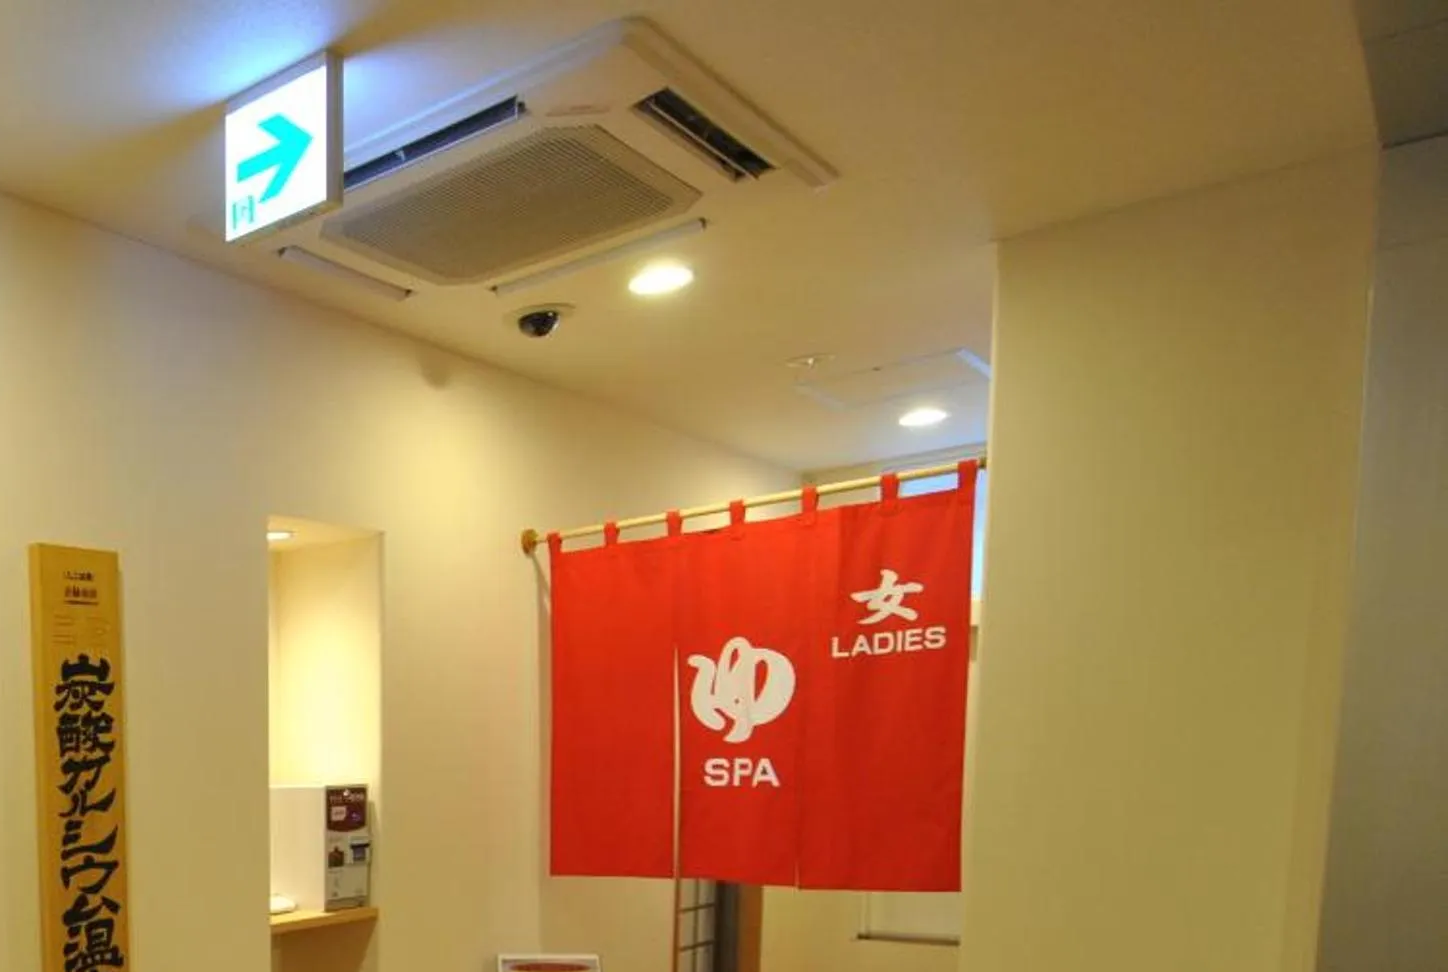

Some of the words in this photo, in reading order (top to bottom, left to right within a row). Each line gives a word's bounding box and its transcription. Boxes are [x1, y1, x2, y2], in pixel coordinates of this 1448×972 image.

[850, 569, 924, 625] 女
[831, 626, 947, 658] LADIES
[687, 636, 796, 743] ゆ
[704, 757, 781, 787] SPA
